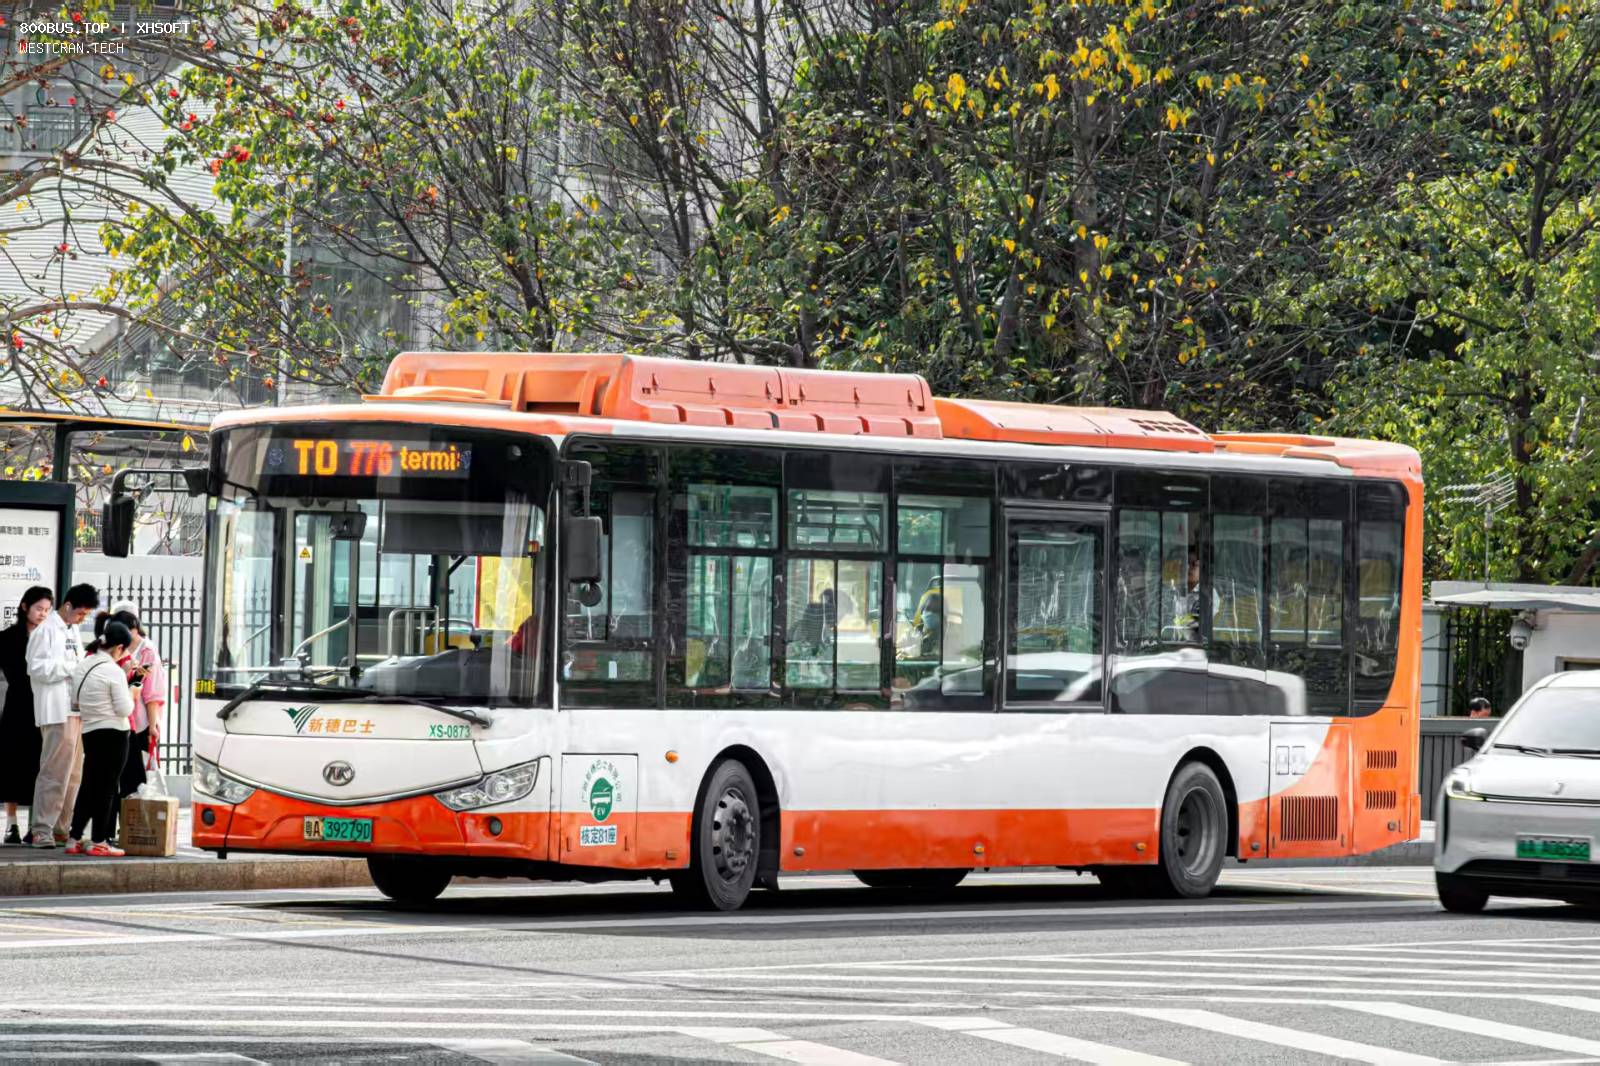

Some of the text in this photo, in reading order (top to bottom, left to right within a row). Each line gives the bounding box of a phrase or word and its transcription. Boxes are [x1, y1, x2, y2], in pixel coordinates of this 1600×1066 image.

[293, 440, 460, 475] TO 776 termi
[429, 724, 471, 738] XS-0873
[581, 827, 616, 844] 核定81座
